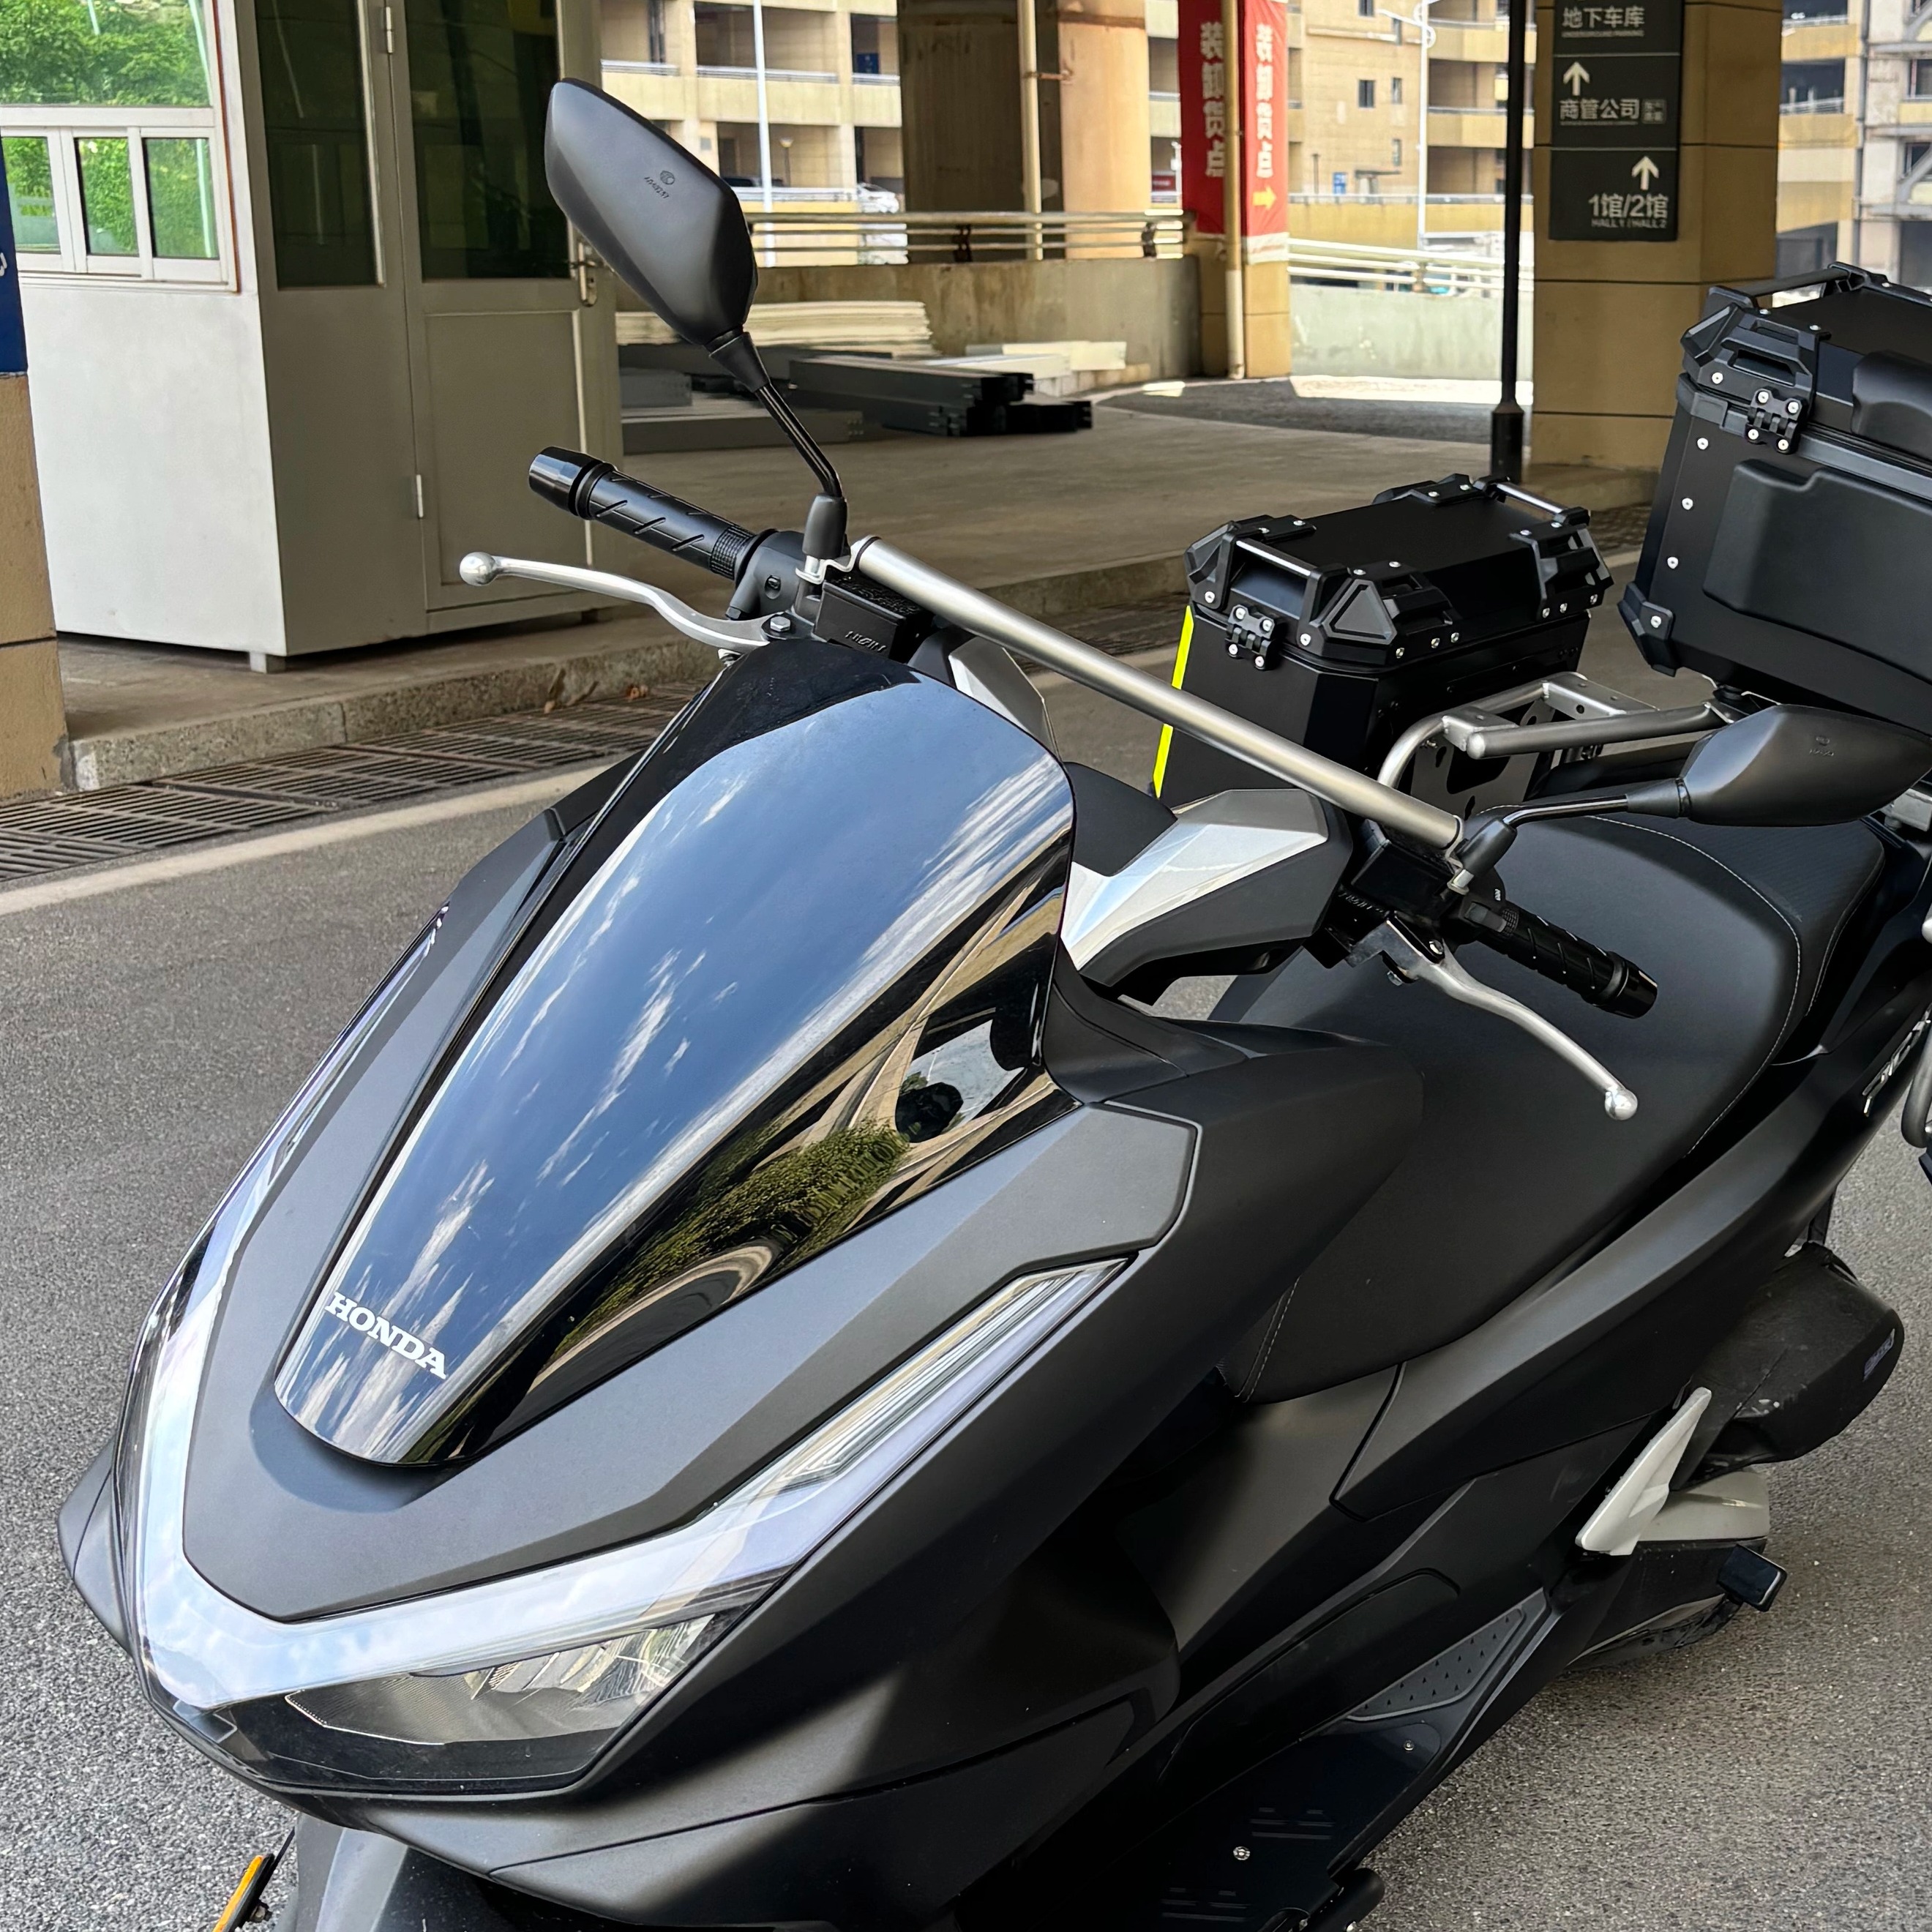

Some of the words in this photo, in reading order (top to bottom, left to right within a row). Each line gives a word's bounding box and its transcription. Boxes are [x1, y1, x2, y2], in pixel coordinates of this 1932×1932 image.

[1562, 7, 1644, 29] 地下车库
[1560, 99, 1640, 120] 商管公司
[1588, 194, 1669, 219] 1馆/2馆
[324, 1292, 446, 1379] HONDA
